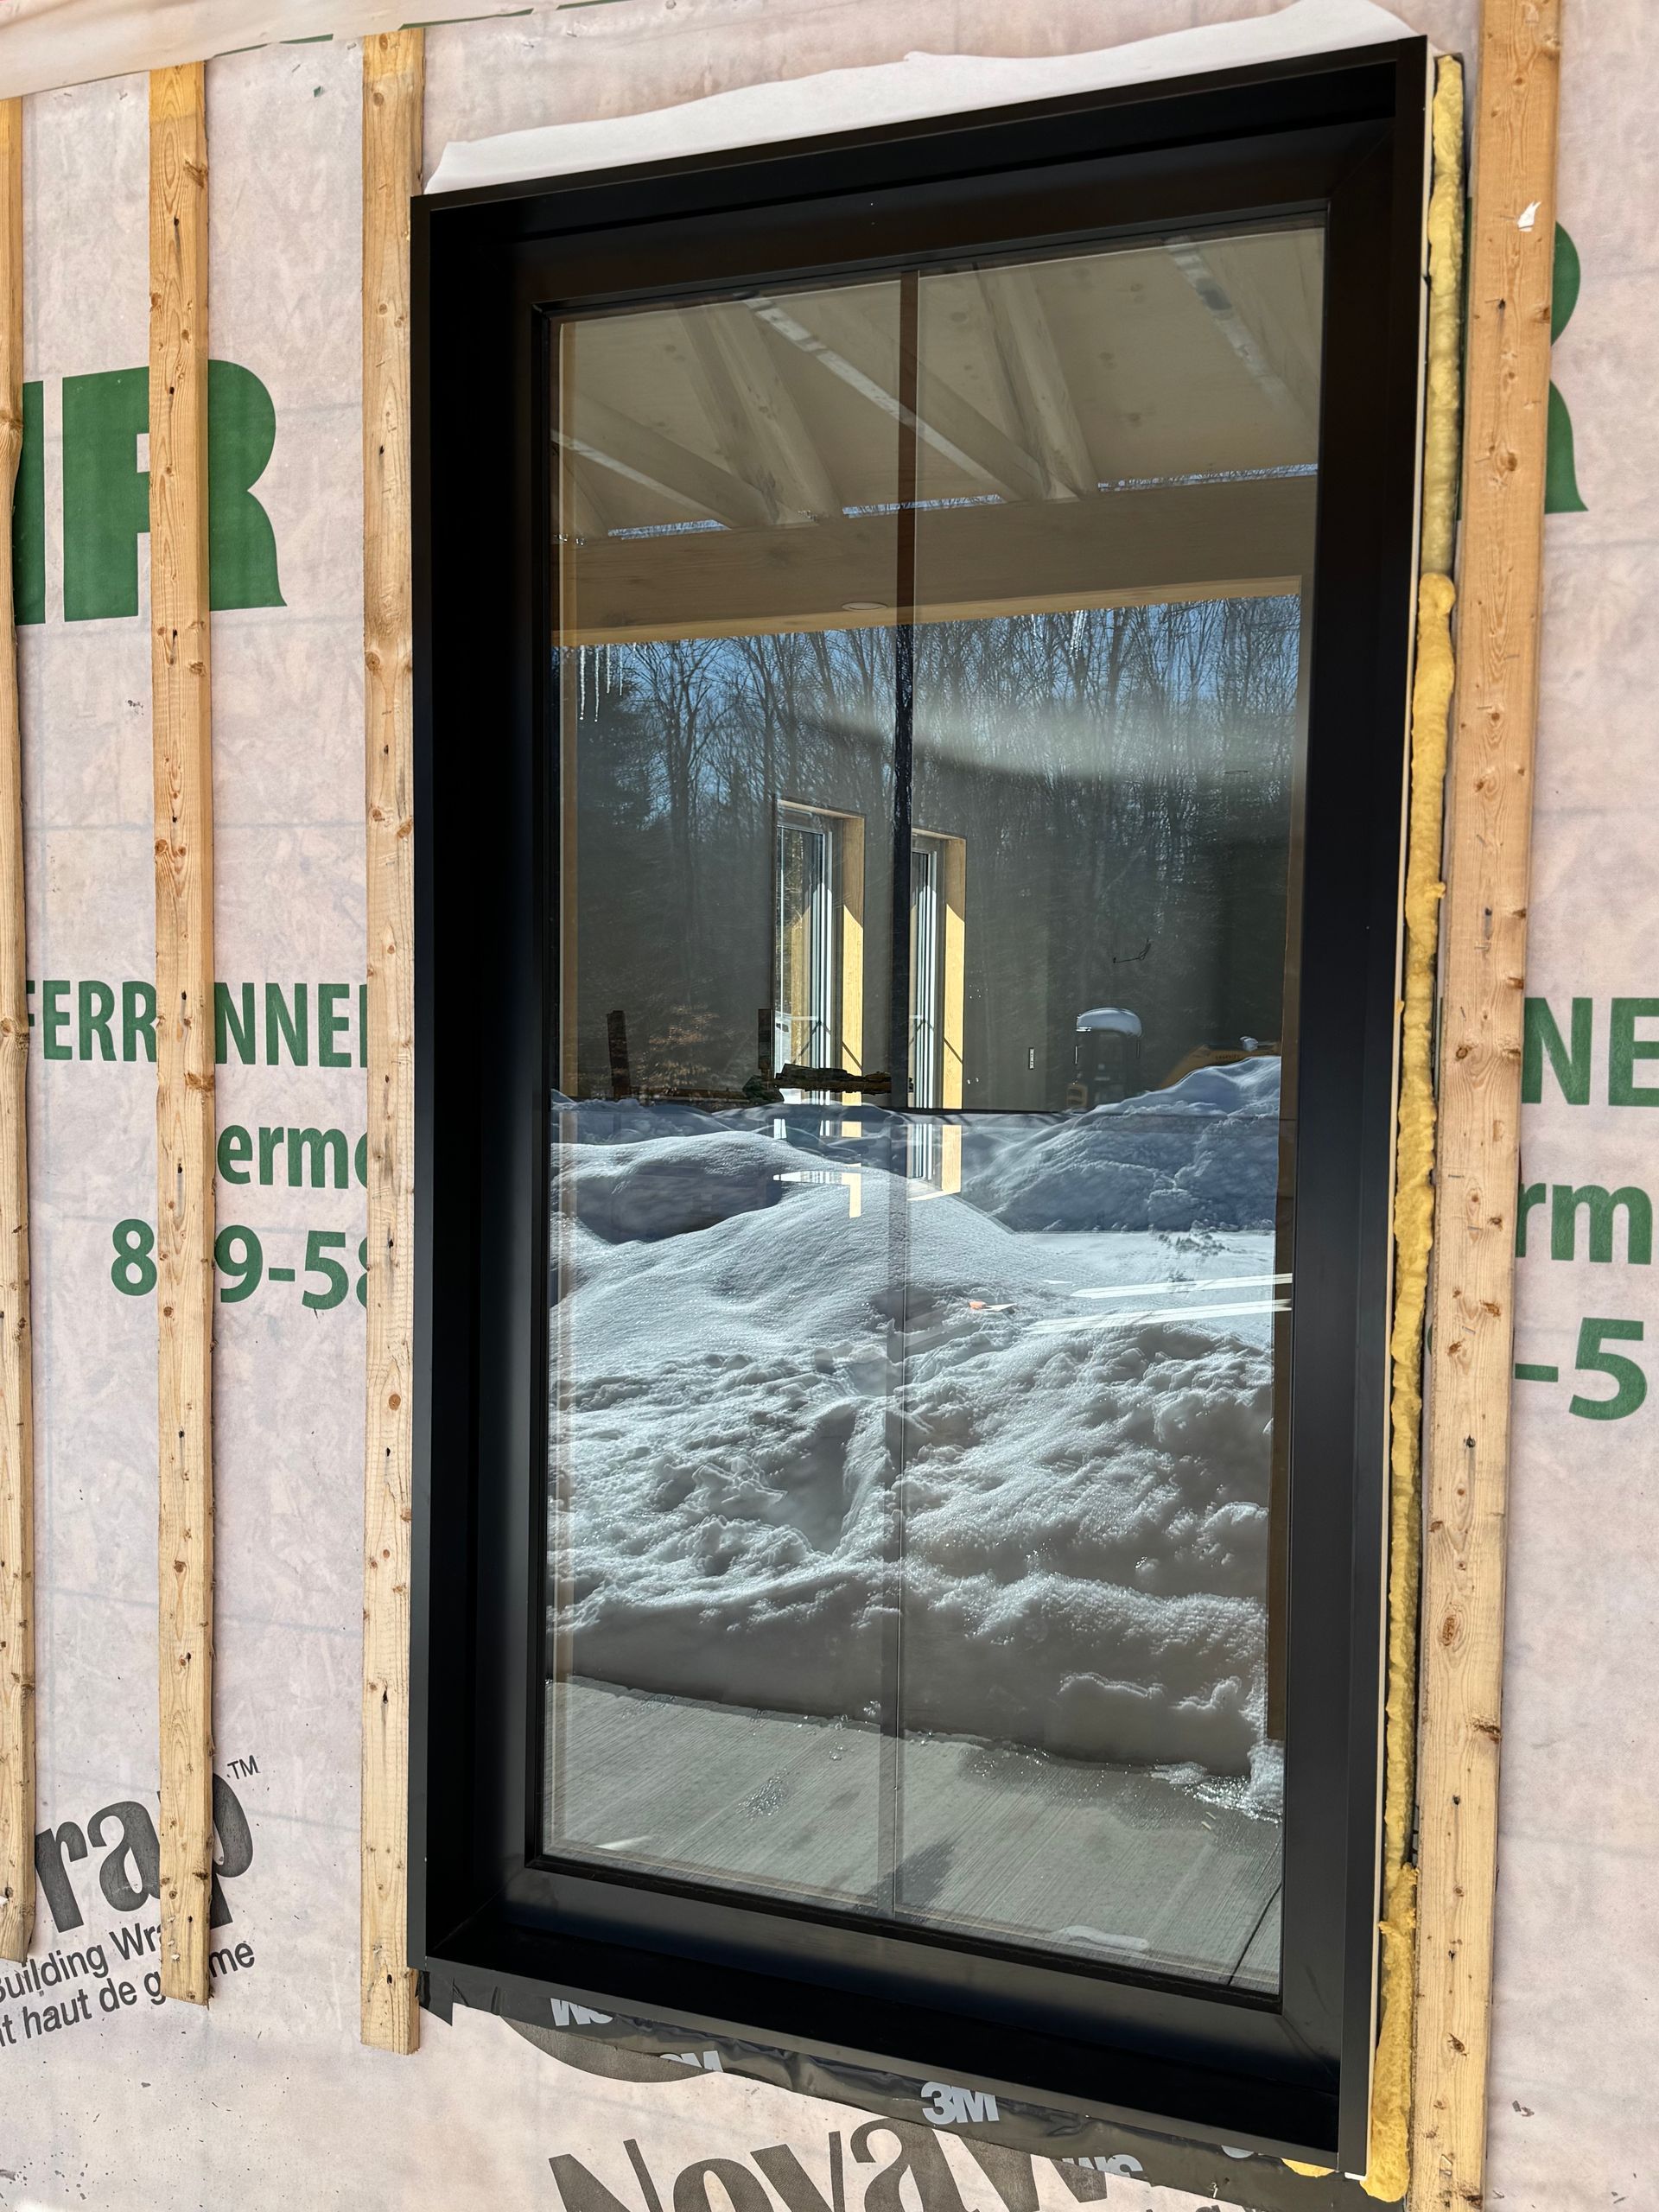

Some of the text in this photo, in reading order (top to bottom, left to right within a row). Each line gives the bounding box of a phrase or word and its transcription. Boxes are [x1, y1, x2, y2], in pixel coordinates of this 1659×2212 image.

[26, 980, 367, 1068] ERRNNE
[1521, 997, 1659, 1108] NE
[217, 1124, 367, 1190] erm
[111, 1218, 367, 1311] 89-5
[109, 1923, 162, 1961] Wr
[22, 1988, 92, 2039] haut
[99, 1978, 137, 2012] de
[143, 1942, 255, 2005] gme
[920, 2082, 1000, 2126] 3M
